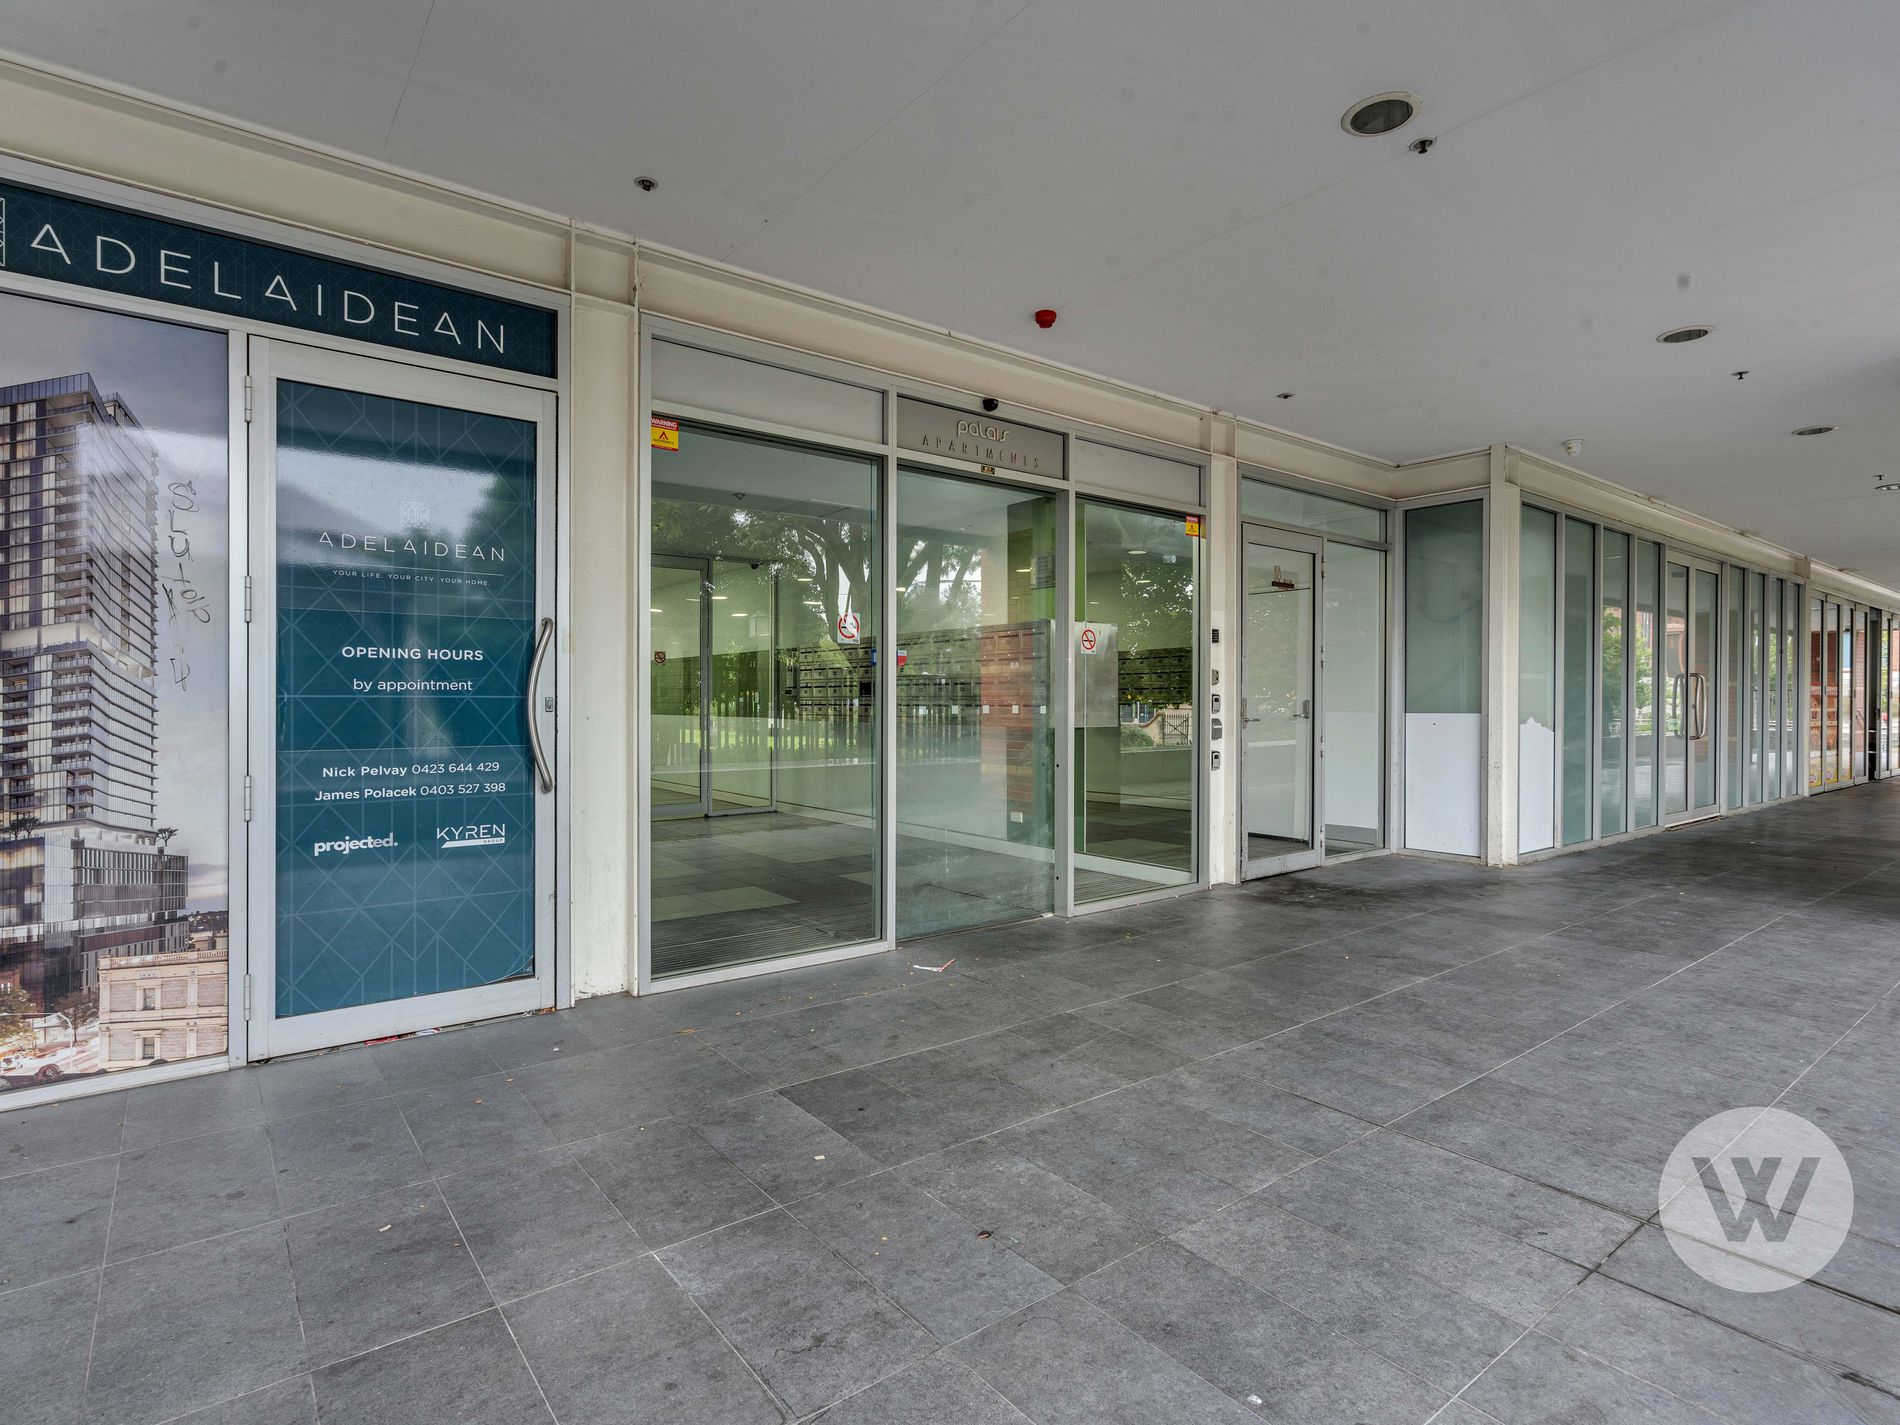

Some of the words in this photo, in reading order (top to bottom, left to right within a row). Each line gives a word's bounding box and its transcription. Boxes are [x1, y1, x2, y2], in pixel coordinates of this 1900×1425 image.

[31, 223, 504, 354] ADELAIDEAN
[922, 434, 1039, 469] APARTMENTS
[319, 531, 505, 562] ADELAIDEAN
[332, 569, 357, 577] YOUR
[388, 573, 411, 581] YOUR
[341, 646, 421, 660] OPENING
[427, 649, 484, 661] HOURS
[353, 678, 372, 693] by
[377, 679, 473, 693] appointment
[322, 766, 356, 778] Nick
[361, 765, 408, 777] Pelvay
[411, 763, 445, 775] 0423
[448, 762, 473, 773] 644
[476, 761, 500, 772] 429
[314, 790, 360, 801] James
[364, 787, 417, 799] Polacek
[420, 784, 454, 796] 0403
[457, 783, 480, 794] 527
[483, 782, 506, 793] 398
[436, 823, 506, 841] KYREN
